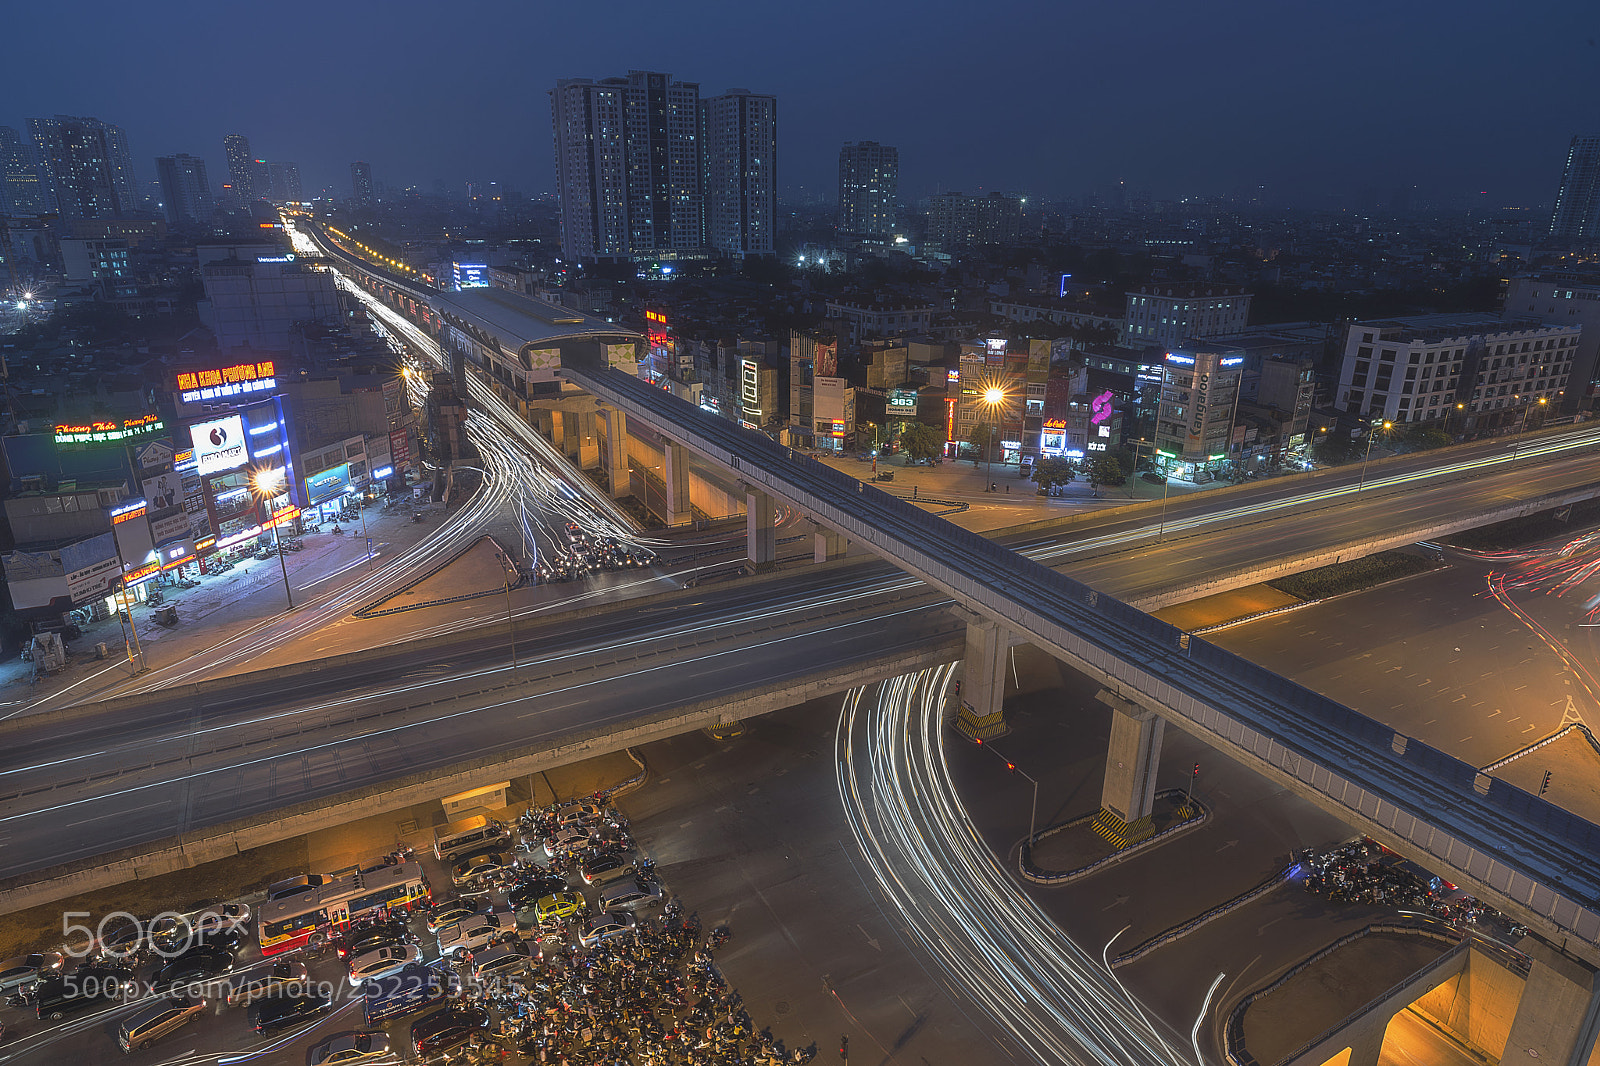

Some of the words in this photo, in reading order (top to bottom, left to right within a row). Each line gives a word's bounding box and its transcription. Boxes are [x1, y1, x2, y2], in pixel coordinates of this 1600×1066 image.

[1165, 353, 1196, 364] Kangaroo
[1219, 358, 1243, 366] Kangaroo
[177, 373, 198, 390] NHA
[198, 370, 222, 387] KHOA
[222, 364, 257, 383] PHƯƠNG
[256, 361, 275, 378] ANH
[1188, 374, 1209, 440] Kangaroo
